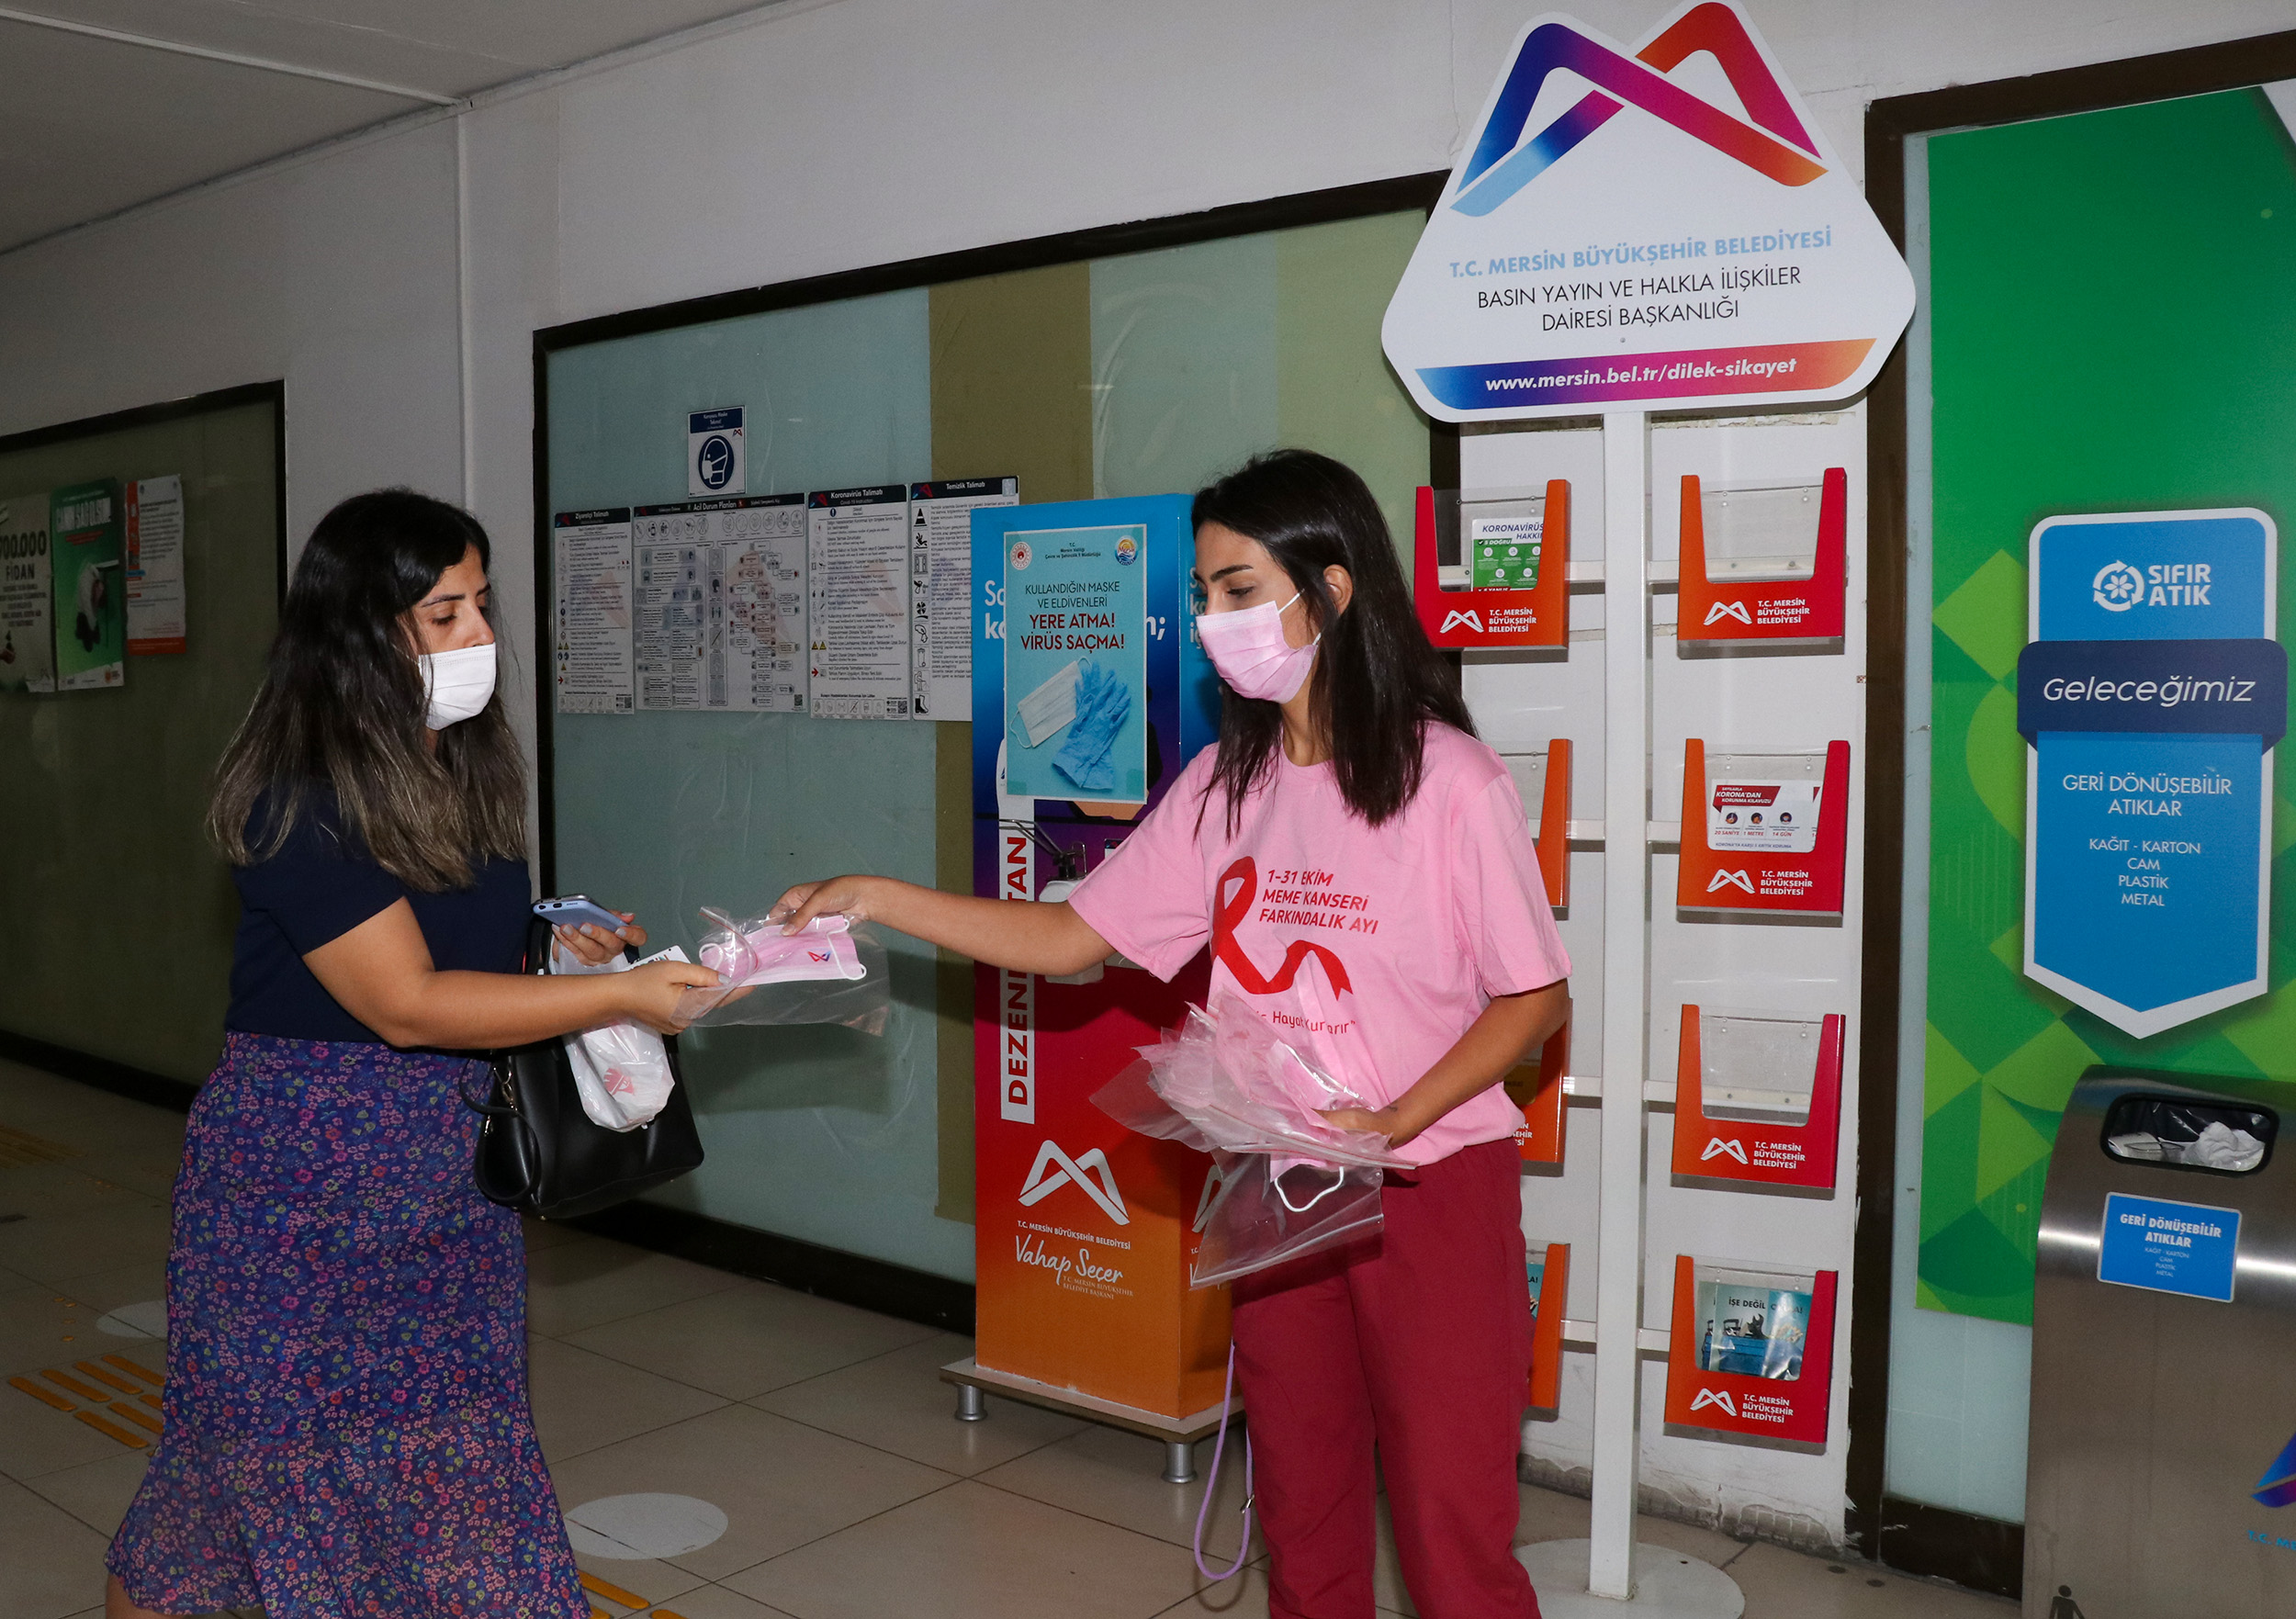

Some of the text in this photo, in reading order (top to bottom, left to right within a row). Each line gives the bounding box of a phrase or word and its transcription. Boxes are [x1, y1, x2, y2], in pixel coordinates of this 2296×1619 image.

[1449, 225, 1832, 277] T.C. MERSİN BÜYÜKŞEHİR BELEDİYESİ
[1478, 264, 1801, 309] BASIN YAYIN VE HALKLA İLİŞKİLER
[1543, 296, 1739, 331] DAİRESİ BAŞKANLIĞI
[1485, 358, 1797, 391] www.mersin.bel.tr/dilek-sikayet
[2148, 564, 2212, 584] SIFIR
[1025, 580, 1120, 595] KULLANDIĞIN MASKE
[2148, 585, 2212, 606] ATIK
[1037, 595, 1108, 608] VE ELDİVENLERİ
[1773, 597, 1806, 607] MERSİN
[1503, 607, 1533, 616] MERSİN
[1757, 606, 1810, 617] BÜYÜKŞEHİR
[1757, 615, 1802, 624] BELEDİYESİ
[1030, 613, 1115, 630] YERE ATMA!
[1489, 615, 1537, 625] BÜYÜKŞEHİR
[1489, 624, 1529, 633] BELEDİYESİ
[1020, 631, 1125, 654] VİRÜS SAÇMA!
[2043, 675, 2256, 707] Geleceğimiz
[2063, 771, 2233, 797] GERİ DÖNÜŞEBİLİR
[2108, 798, 2183, 816] ATIKLAR
[2089, 836, 2130, 851] KAĞIT
[2143, 840, 2200, 854] KARTON
[2127, 857, 2160, 871] CAM
[1267, 869, 1334, 887] 1-31 EKİM
[1761, 870, 1809, 879] T.C. MERSİN
[2119, 873, 2169, 889] PLASTİK
[1761, 878, 1814, 888] BÜYÜKŞEHİR
[1760, 887, 1805, 896] BELEDİYESİ
[1262, 888, 1369, 912] MEME KANSERİ
[2121, 894, 2165, 906] METAL
[1259, 908, 1379, 935] FARKINDALIK AYI
[1007, 837, 1028, 1105] DEZENTAN
[1770, 1142, 1802, 1152] MERSİN
[1753, 1149, 1806, 1162] BÜYÜKŞEHİR
[1753, 1158, 1796, 1169] BELEDİYESİ
[2121, 1214, 2222, 1238] GERİ DÖNÜŞEBİLİR
[1017, 1220, 1131, 1250] T.C. MERSİN BÜYÜKŞEHİR BELEDİYESİ
[2145, 1231, 2192, 1247] ATIKLAR
[1016, 1233, 1123, 1286] Vahap Seçer
[1728, 1296, 1740, 1307] İŞE
[1742, 1299, 1766, 1310] DEĞİL
[1742, 1393, 1790, 1406] T.C. MERSİN
[1742, 1401, 1794, 1416] BÜYÜKŞEHİR
[1741, 1411, 1785, 1423] BELEDİYESİ
[2245, 1529, 2273, 1546] T.C.
